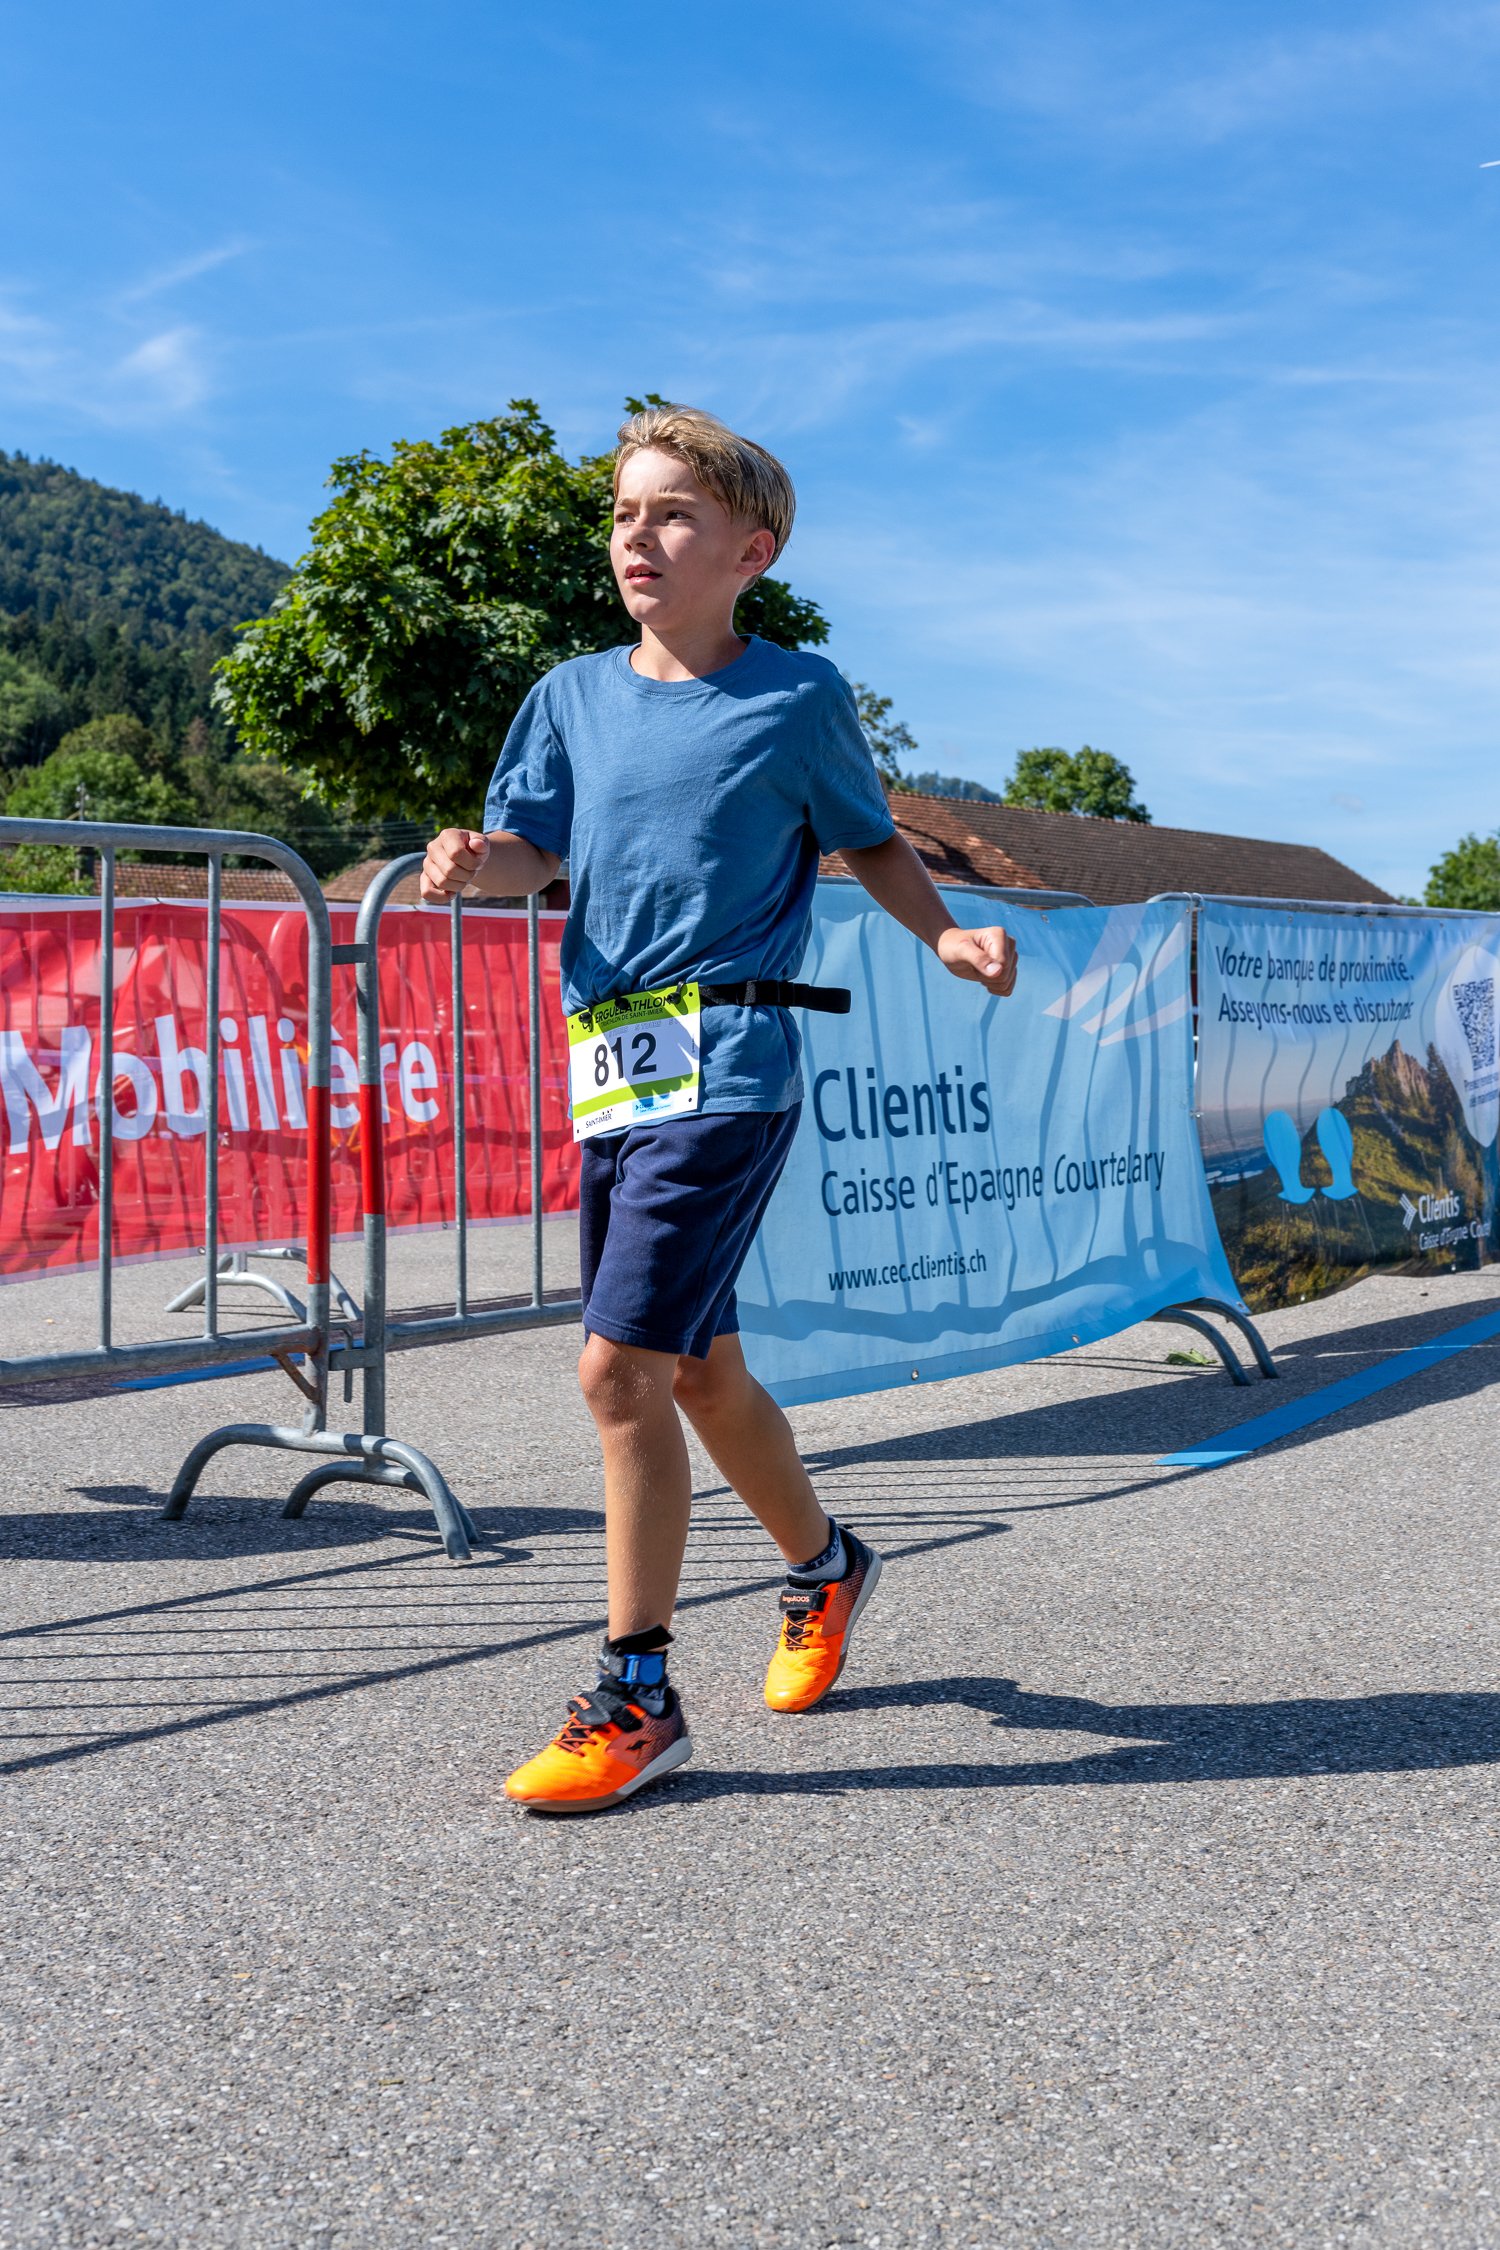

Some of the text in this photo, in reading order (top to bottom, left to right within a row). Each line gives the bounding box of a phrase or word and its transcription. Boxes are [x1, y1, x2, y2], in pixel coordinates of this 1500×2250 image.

[1216, 945, 1415, 989] Votre banque de proximité.
[621, 1014, 629, 1022] DE
[1218, 992, 1332, 1031] Asseyons-nous
[1334, 999, 1352, 1023] et
[594, 1032, 657, 1086] 812
[812, 1065, 991, 1142] Clientis
[820, 1145, 1166, 1217] Caisse d'Epargne Courtelary
[1418, 1190, 1460, 1223] Clientis
[828, 1248, 988, 1292] www.cec.clientis.ch
